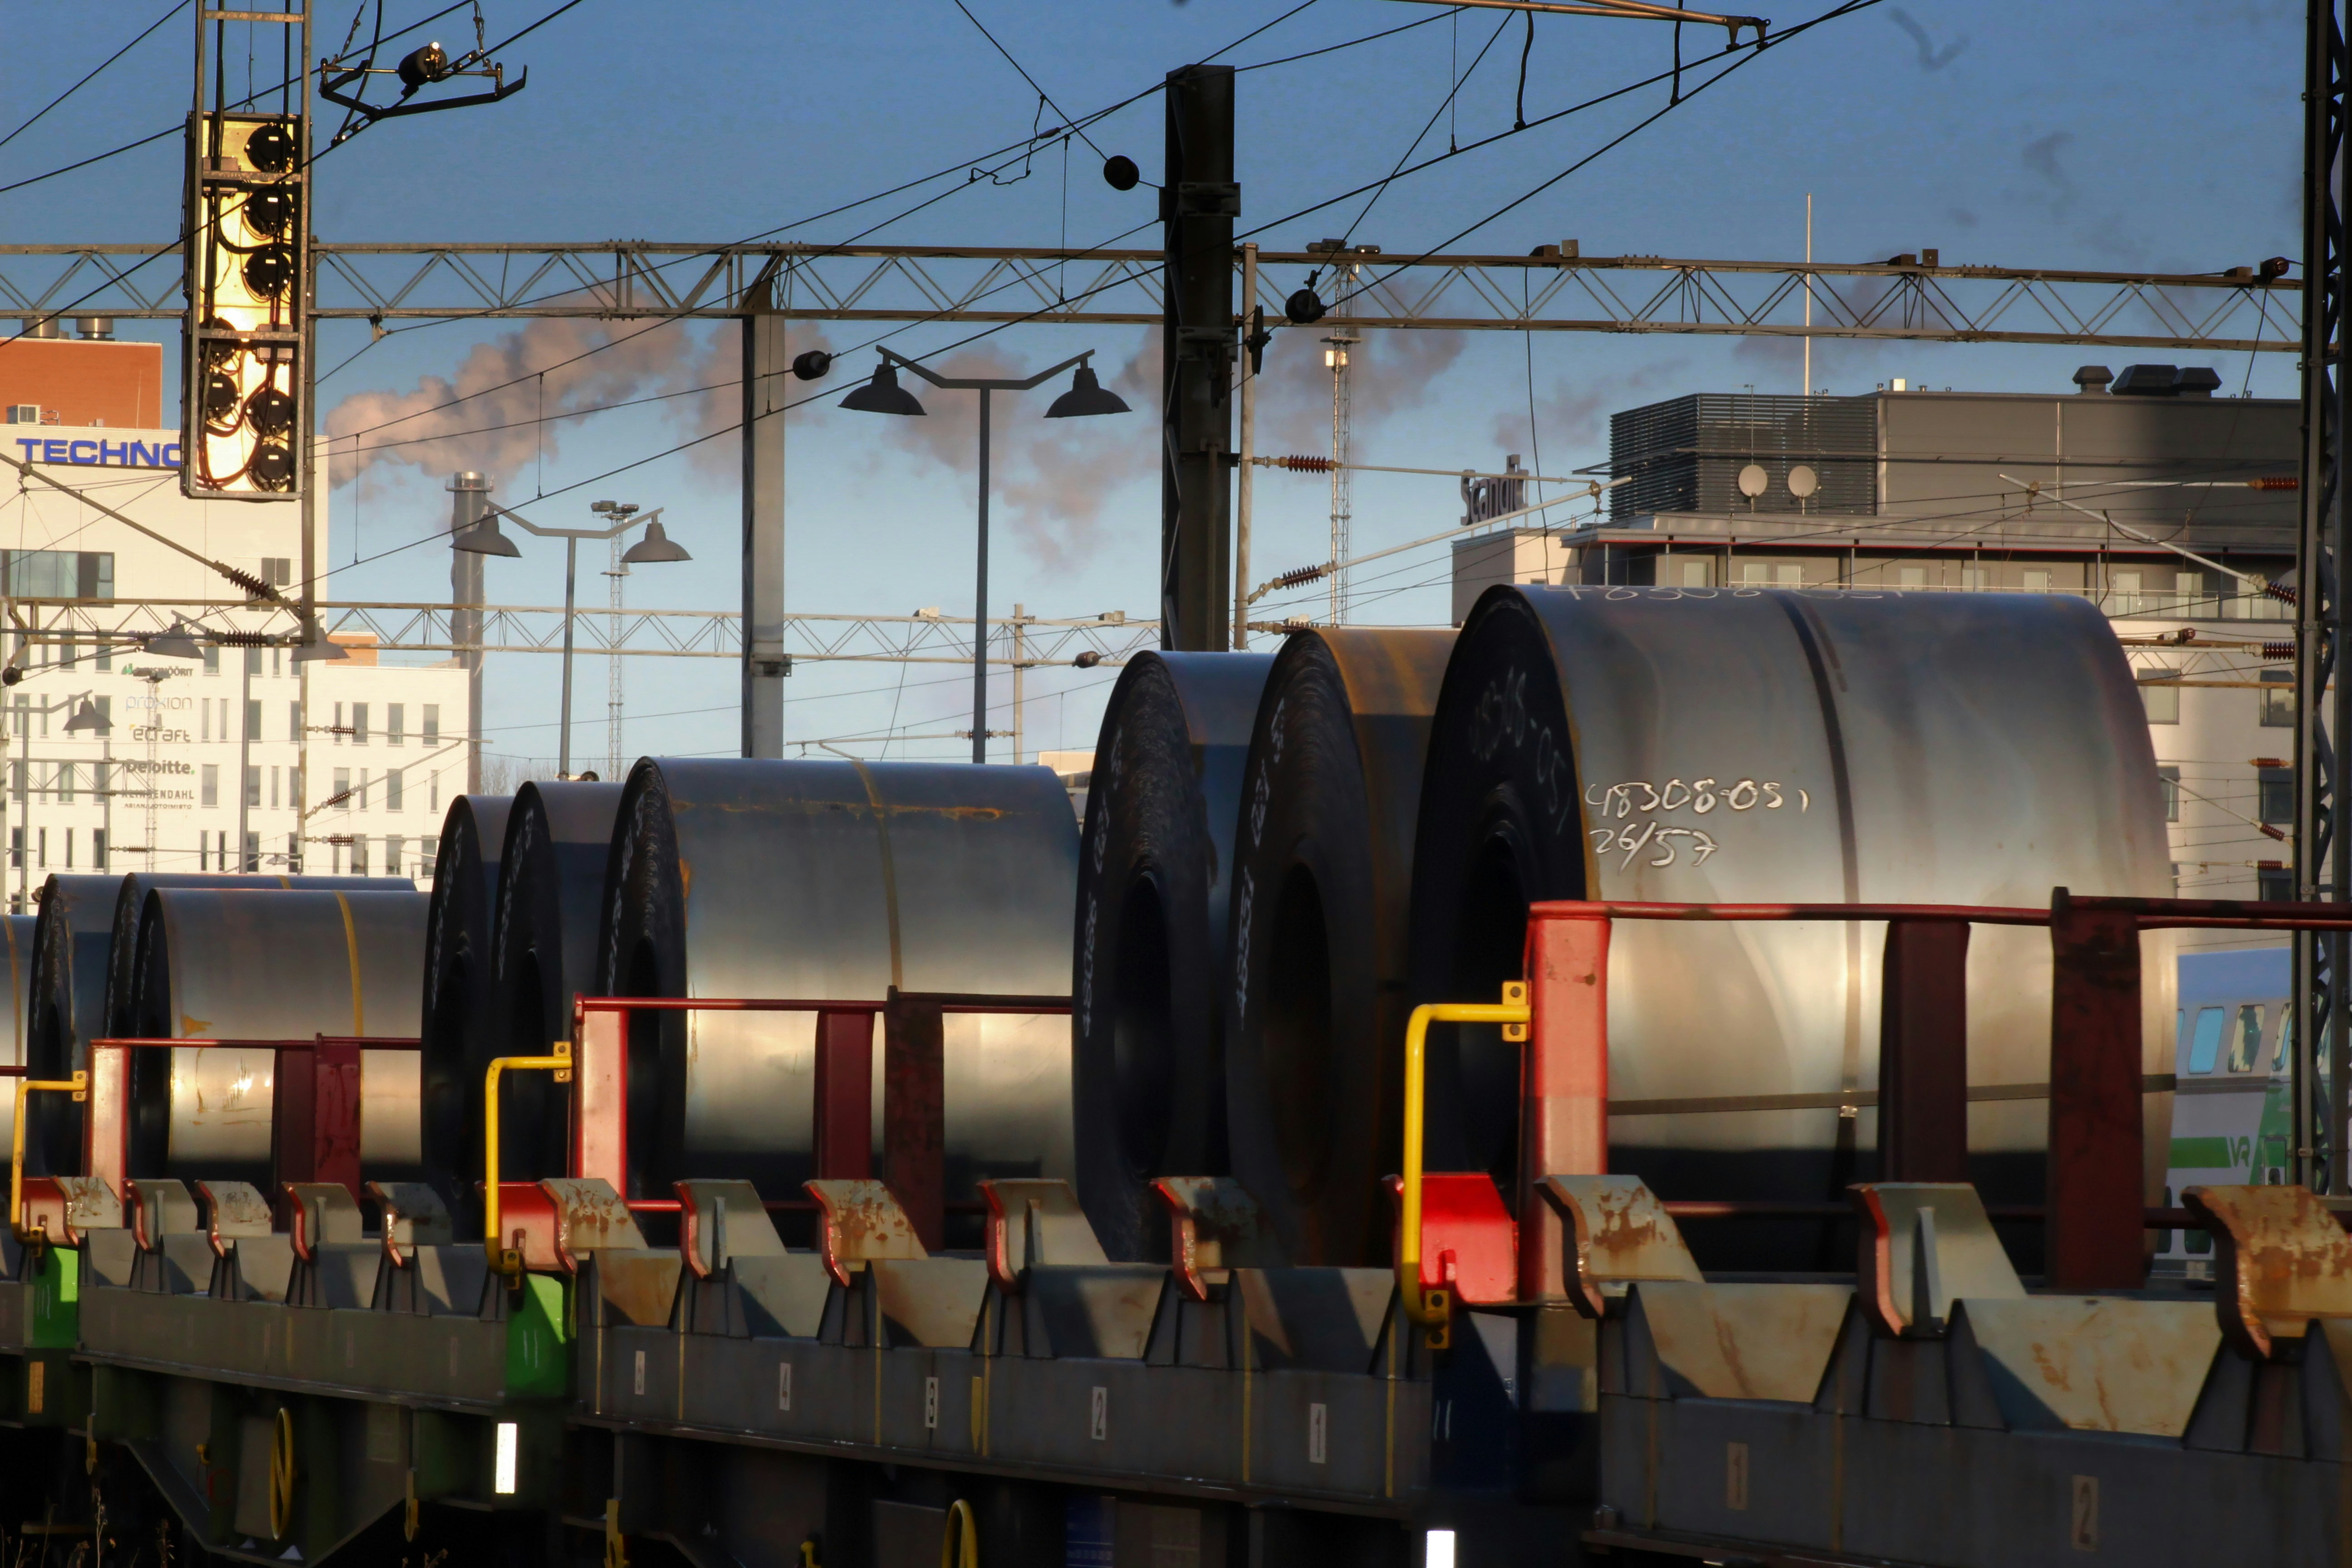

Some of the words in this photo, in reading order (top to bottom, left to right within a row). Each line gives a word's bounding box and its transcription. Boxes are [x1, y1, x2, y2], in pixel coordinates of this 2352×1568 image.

[2230, 1136, 2250, 1167] VR
[1095, 1392, 1103, 1436] 2
[2078, 1480, 2092, 1544] 2
